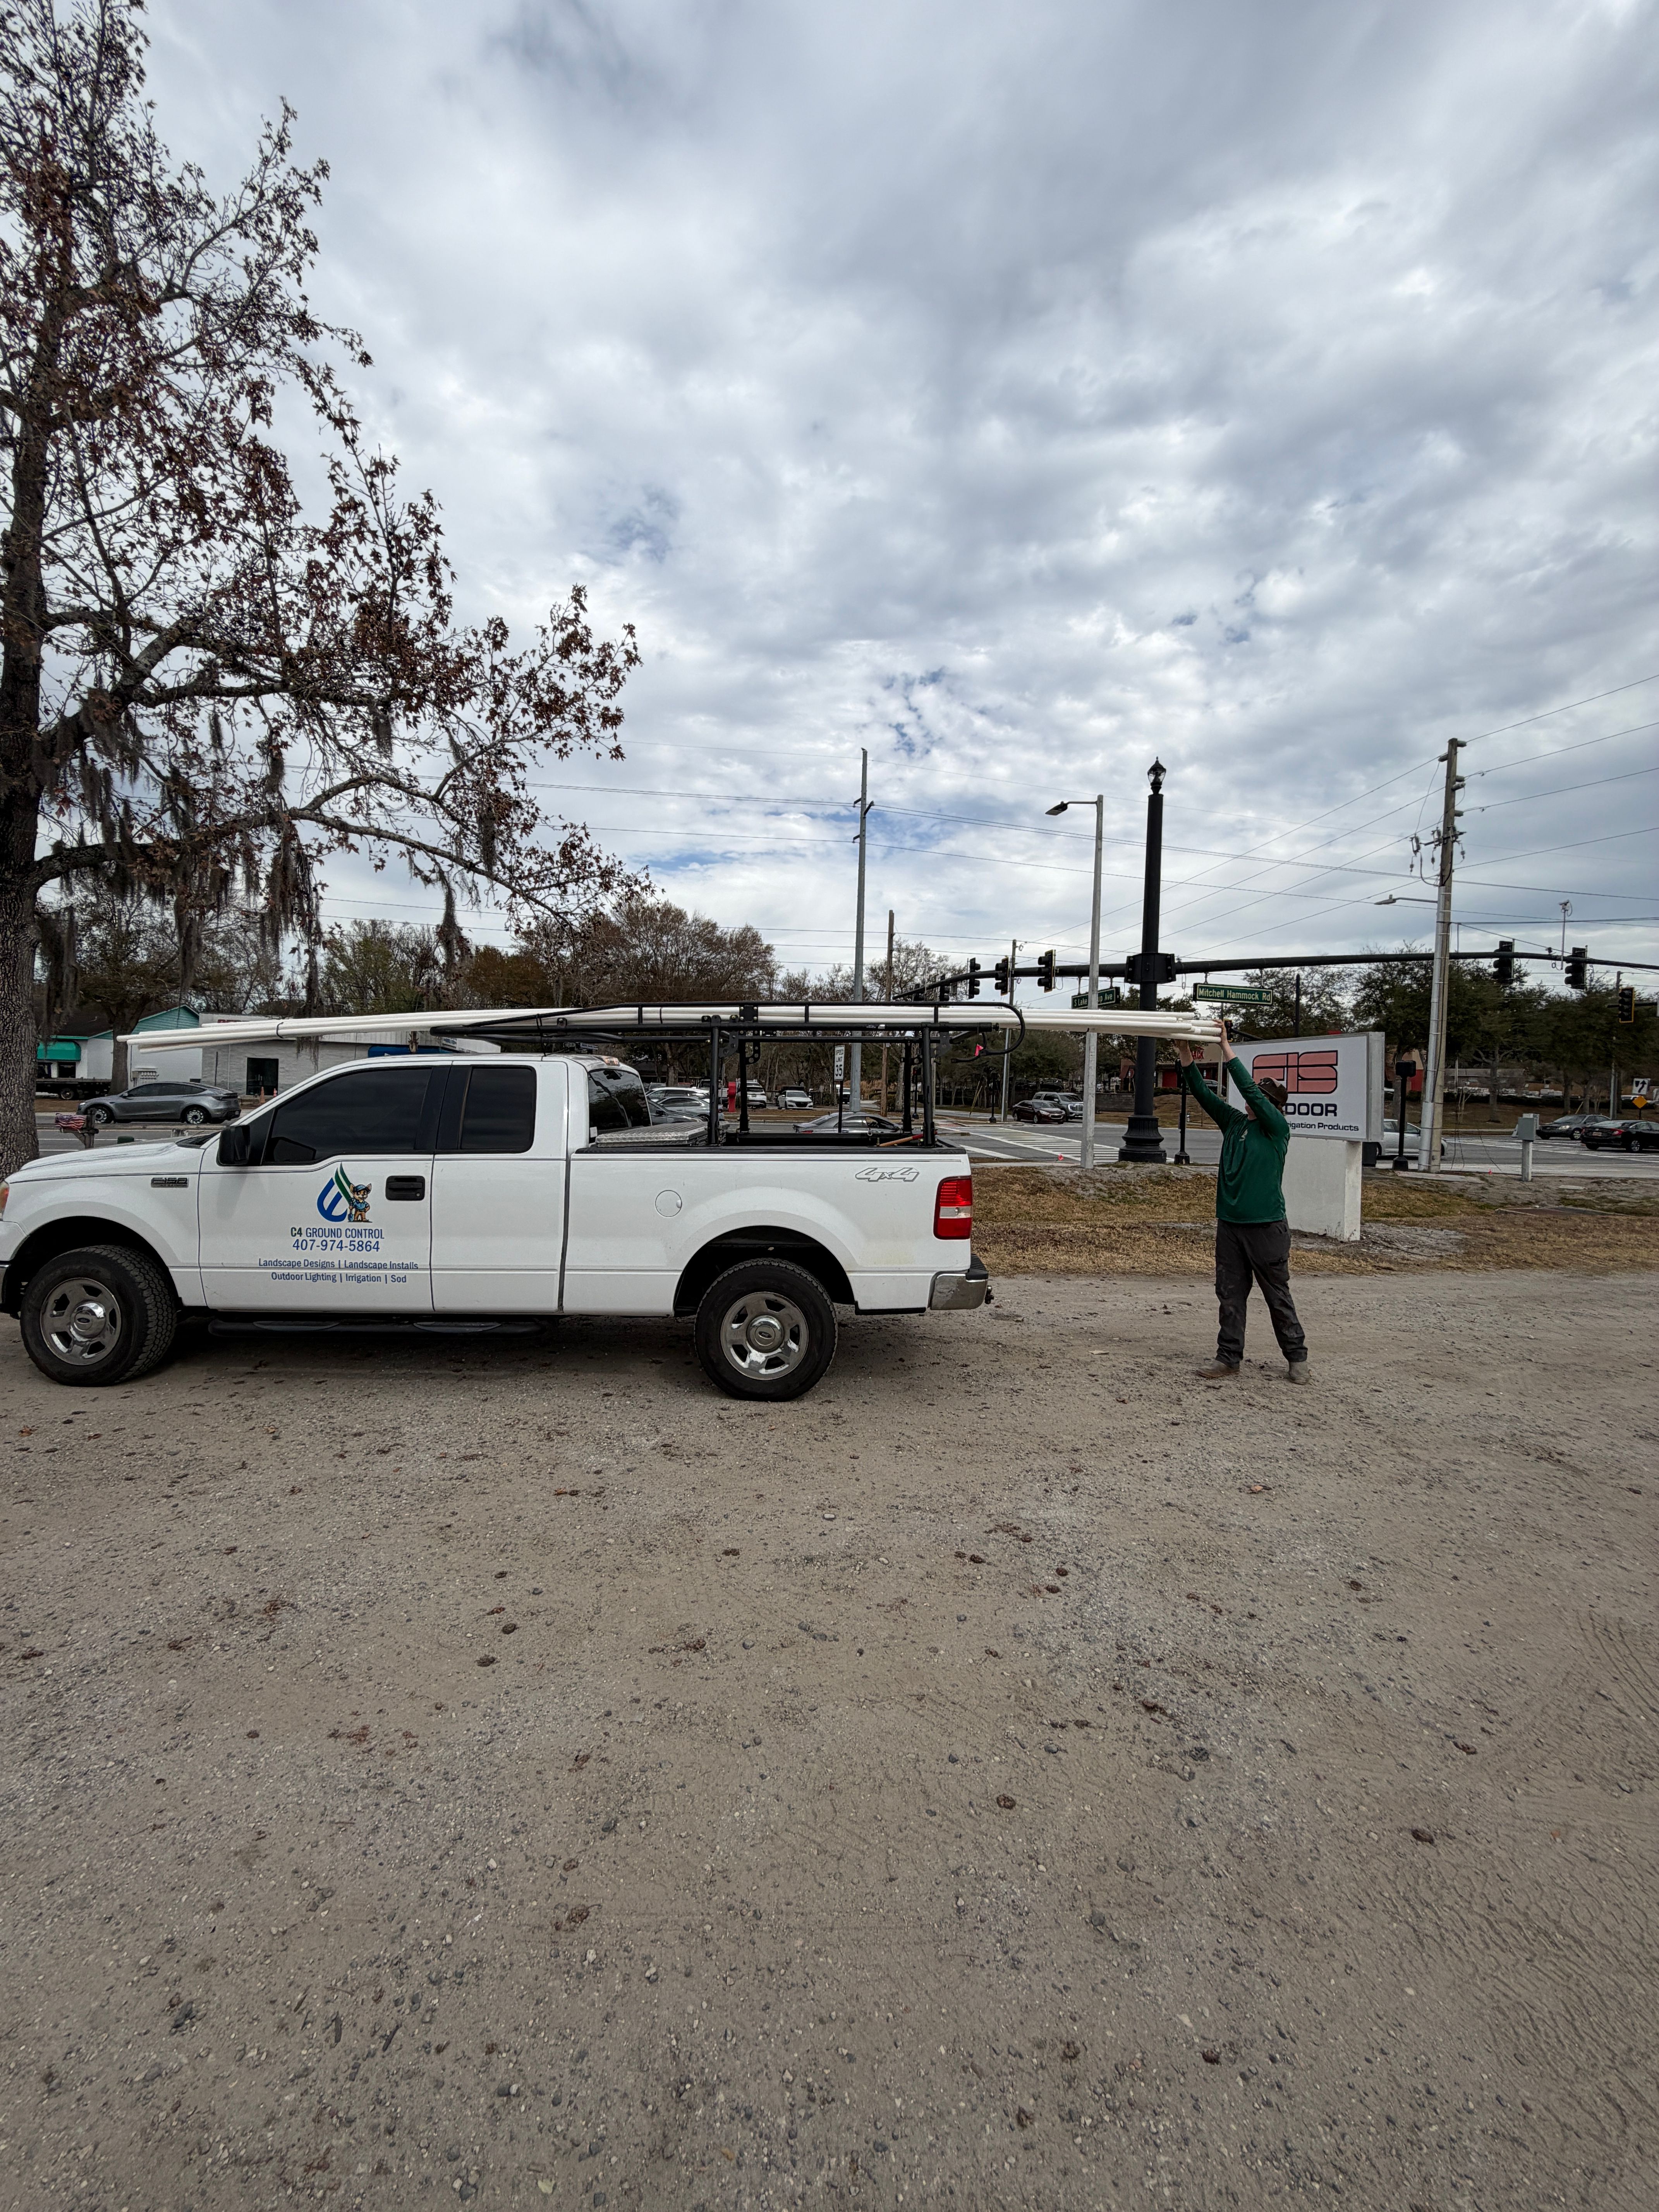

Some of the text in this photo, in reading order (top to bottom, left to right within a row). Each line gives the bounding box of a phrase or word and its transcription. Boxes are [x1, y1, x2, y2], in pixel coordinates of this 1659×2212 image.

[1104, 993, 1113, 1001] Ave
[1199, 988, 1271, 1001] Mitchell Hammock Rd
[835, 1064, 842, 1077] 35
[1285, 1103, 1337, 1116] DOOR
[1317, 1122, 1359, 1131] Products
[855, 1168, 920, 1182] 4x4
[290, 1227, 385, 1239] C4 GROUND CONTROL
[292, 1239, 380, 1252] 407-974-5864
[259, 1258, 301, 1268] Landscape
[304, 1259, 335, 1269] Designs
[344, 1260, 387, 1269] Landscape
[390, 1261, 418, 1269] Installs
[271, 1272, 303, 1280] Outdoor
[305, 1273, 337, 1283] Lighting
[346, 1273, 381, 1283] Irrigation
[391, 1274, 407, 1283] Sod
